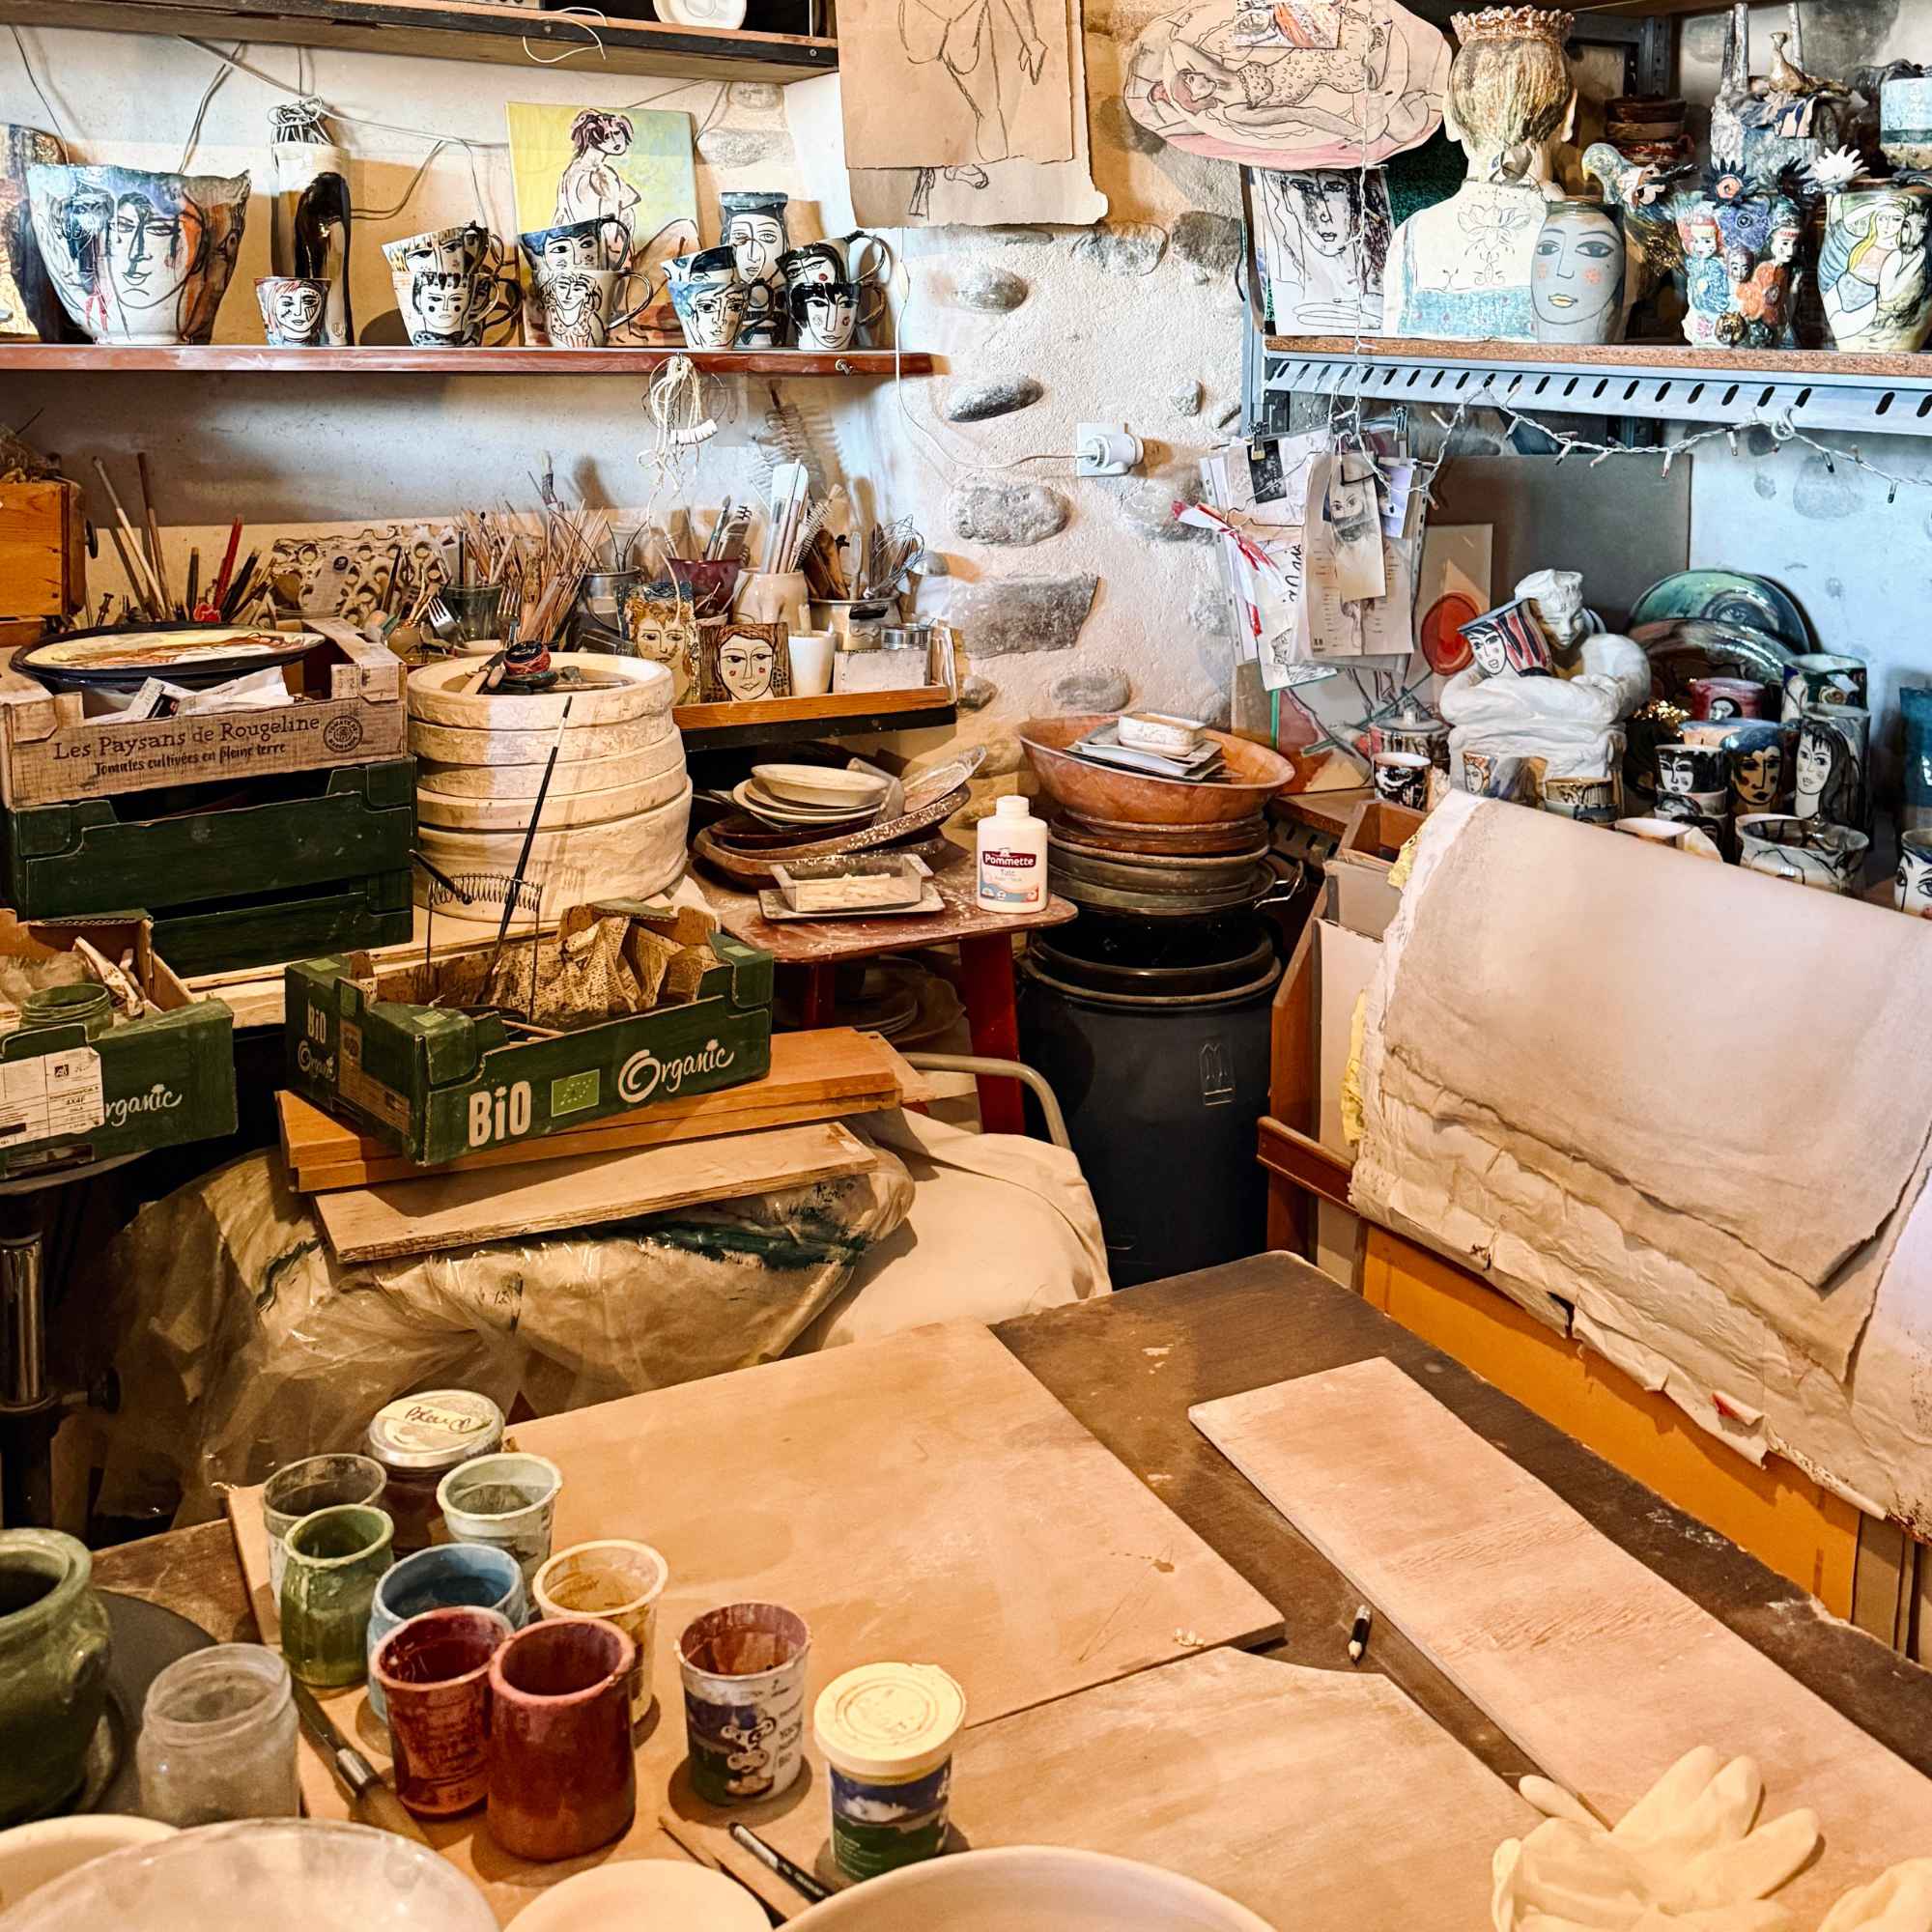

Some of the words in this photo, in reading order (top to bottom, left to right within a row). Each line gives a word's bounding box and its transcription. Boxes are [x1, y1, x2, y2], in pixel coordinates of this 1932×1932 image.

[53, 742, 92, 760] Les
[99, 731, 186, 757] Paysans
[192, 726, 214, 743] de
[220, 715, 320, 742] Rougeline
[94, 759, 145, 777] Tomates
[147, 751, 200, 768] cultivées
[202, 753, 216, 763] en
[219, 745, 253, 765] pleine
[257, 743, 286, 756] terre
[984, 853, 1034, 866] Pommette
[617, 1037, 735, 1103] Organic
[104, 1083, 183, 1127] rganic
